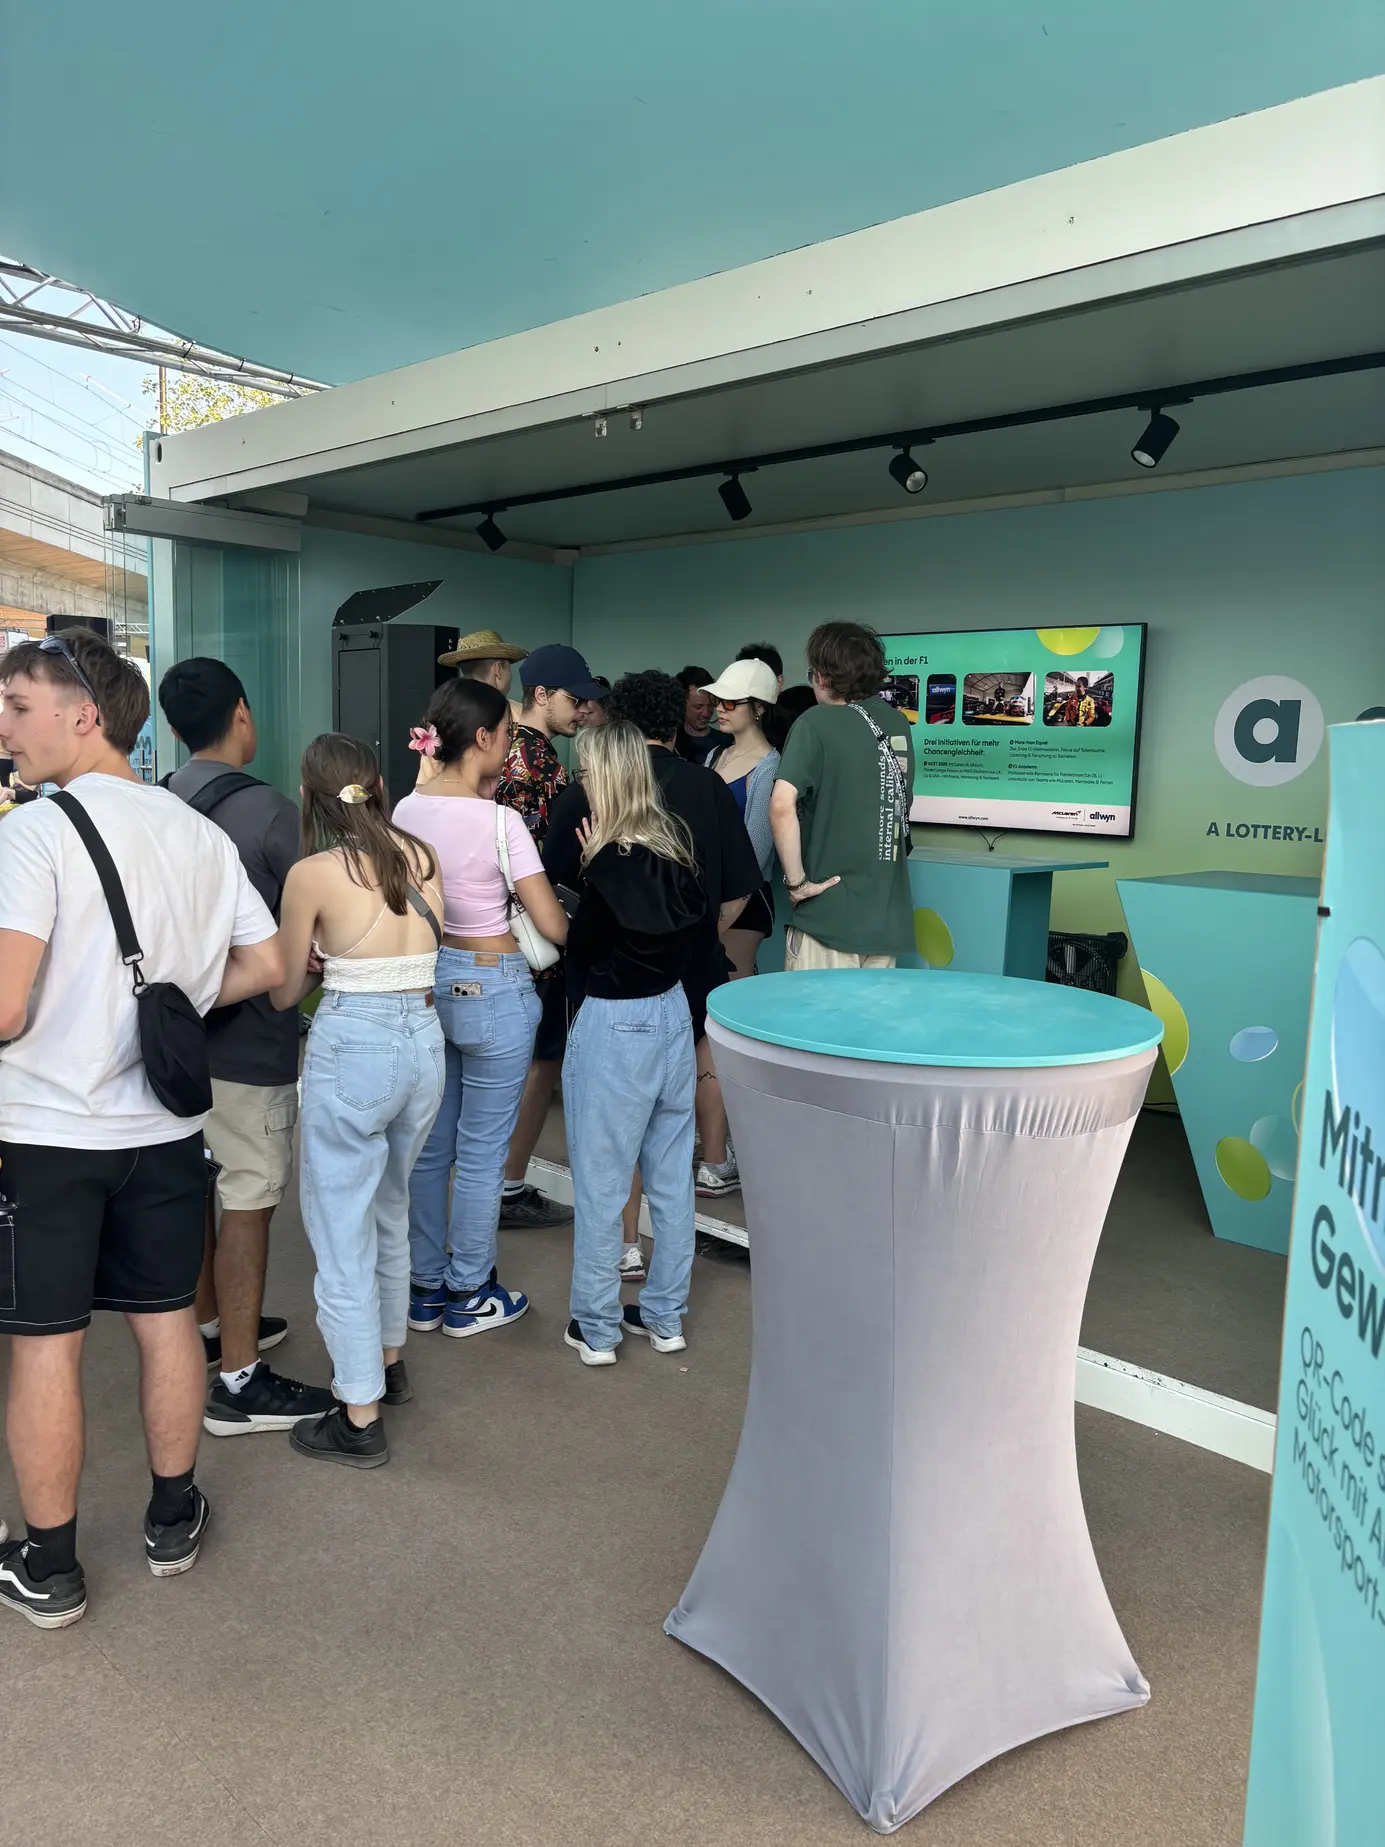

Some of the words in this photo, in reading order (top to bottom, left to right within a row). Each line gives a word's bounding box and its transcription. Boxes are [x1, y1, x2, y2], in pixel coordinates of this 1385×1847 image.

[895, 657, 902, 665] in
[904, 656, 918, 664] der
[920, 656, 928, 664] F1
[1234, 698, 1302, 763] a
[883, 808, 894, 861] internal
[1089, 812, 1116, 823] allwyn
[1206, 822, 1220, 836] A
[1226, 823, 1324, 842] LOTTERY-L
[1320, 1089, 1385, 1224] Mitr
[1301, 1326, 1374, 1468] QR-Code
[1297, 1378, 1338, 1478] Glück
[1341, 1459, 1368, 1527] mit
